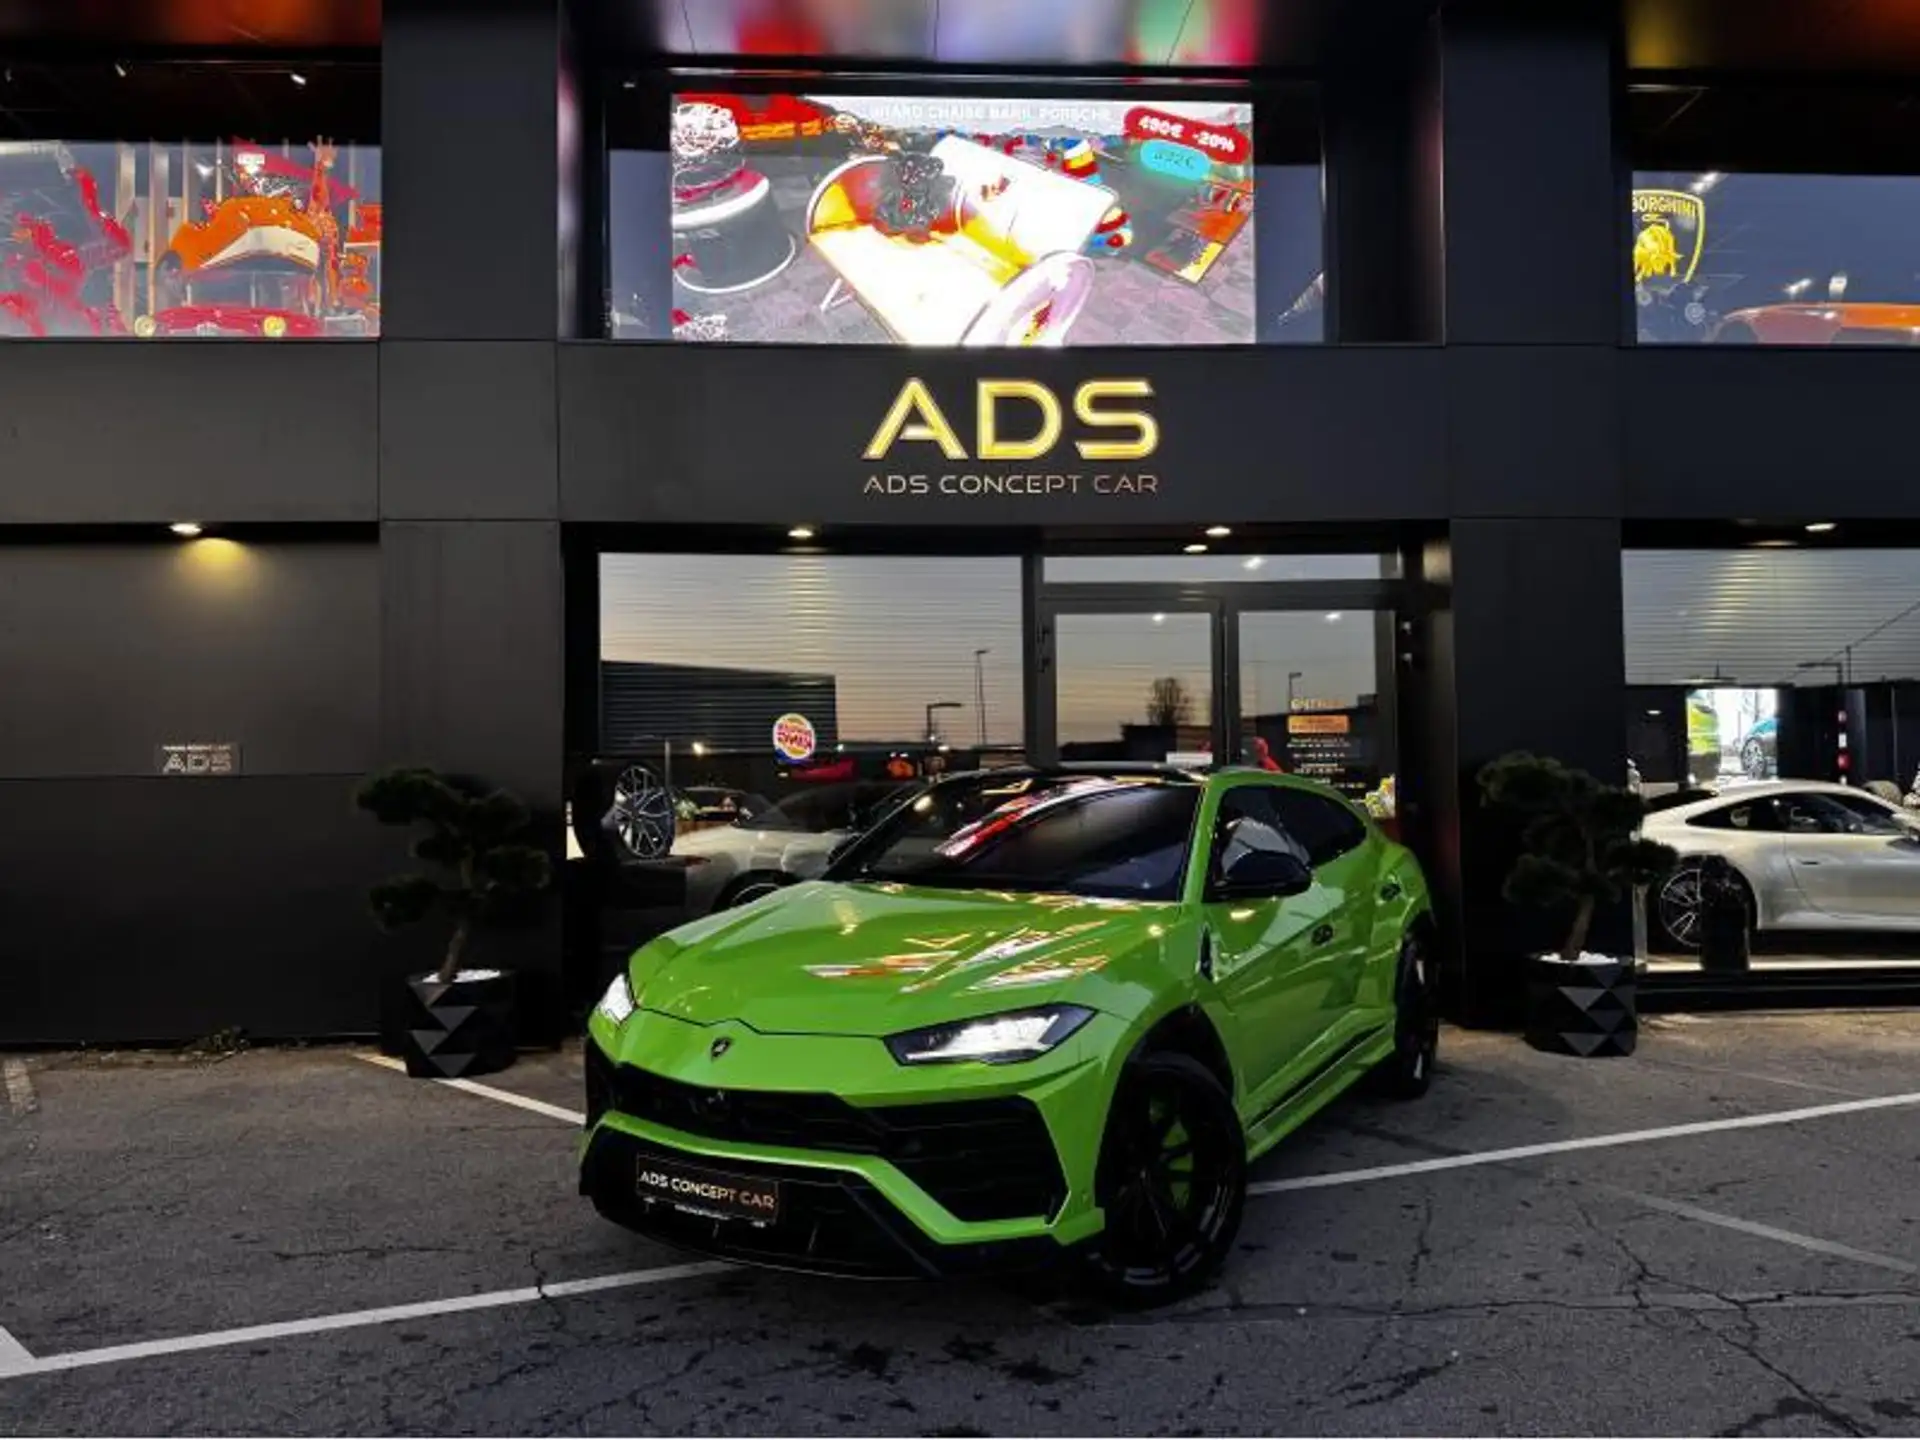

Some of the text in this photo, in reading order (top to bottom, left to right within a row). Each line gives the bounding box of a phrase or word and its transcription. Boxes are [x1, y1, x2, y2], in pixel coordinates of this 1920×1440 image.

[861, 376, 1159, 460] ADS
[863, 475, 1159, 493] ADS CONCEPT CAR
[162, 752, 232, 776] ADS
[639, 1171, 774, 1209] ADS CONCEPT CAR
